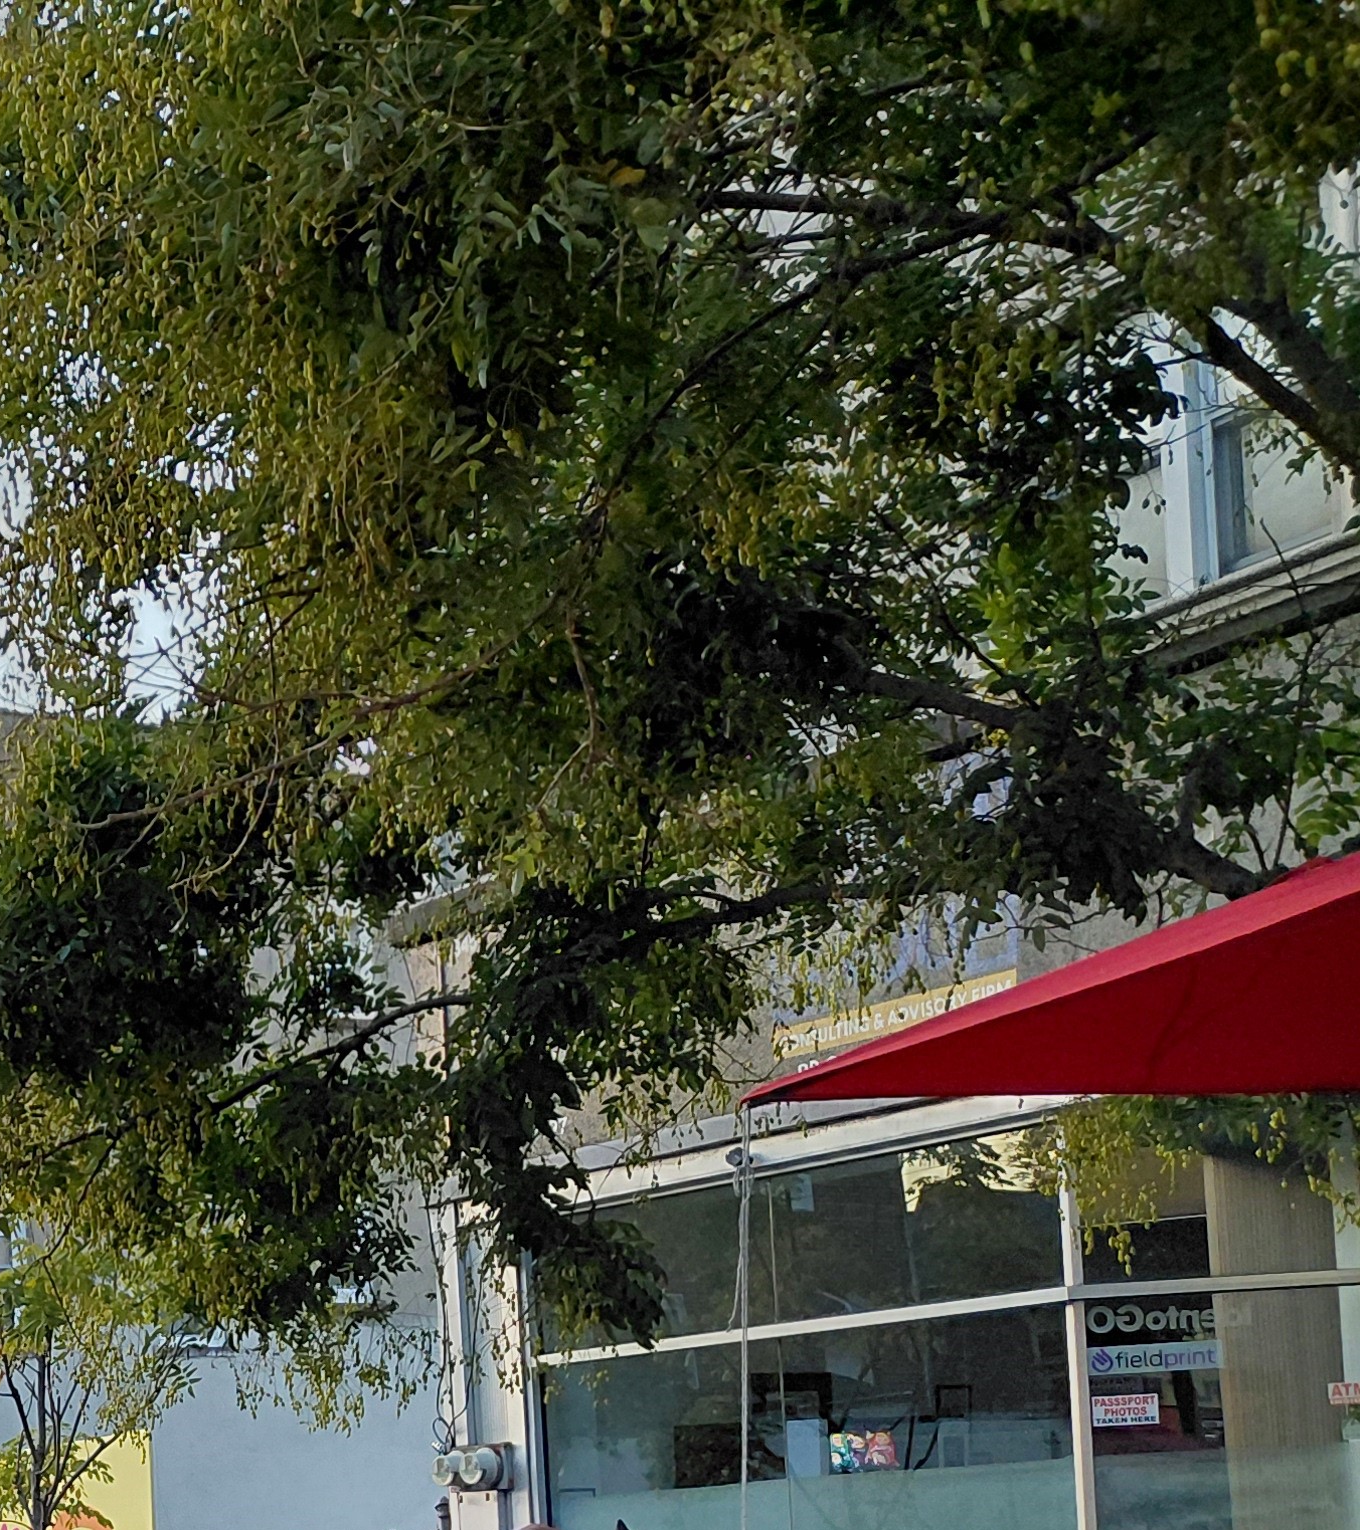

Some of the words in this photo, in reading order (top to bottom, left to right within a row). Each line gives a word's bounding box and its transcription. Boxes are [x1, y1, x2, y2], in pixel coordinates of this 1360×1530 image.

[1115, 1349, 1217, 1369] fieldprint
[1094, 1395, 1156, 1407] PASSSPORT
[1104, 1407, 1148, 1417] PHOTOS
[1096, 1417, 1128, 1425] TAKEN
